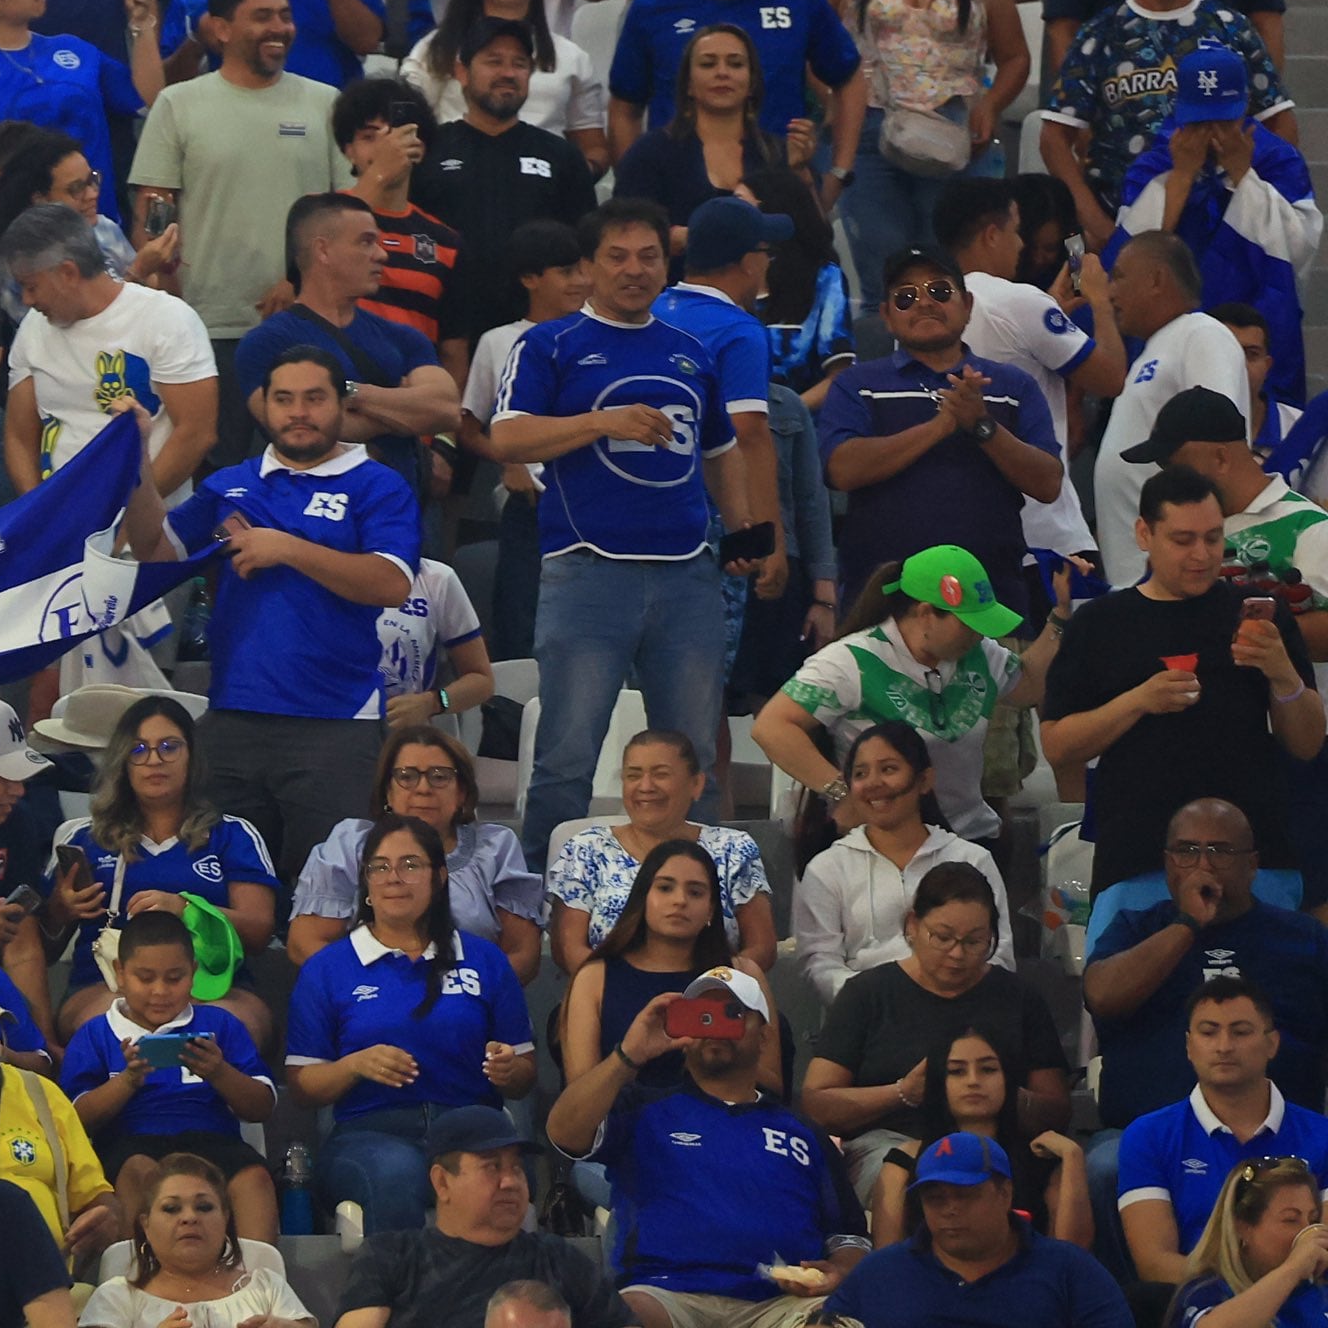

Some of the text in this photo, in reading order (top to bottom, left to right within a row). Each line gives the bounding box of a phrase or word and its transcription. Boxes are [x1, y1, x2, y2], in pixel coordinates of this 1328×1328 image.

[758, 7, 790, 29] ES
[1104, 68, 1177, 104] BARRA
[518, 157, 552, 179] ES
[303, 490, 349, 521] ES
[198, 861, 222, 877] ES
[441, 968, 482, 996] ES
[762, 1126, 810, 1166] ES
